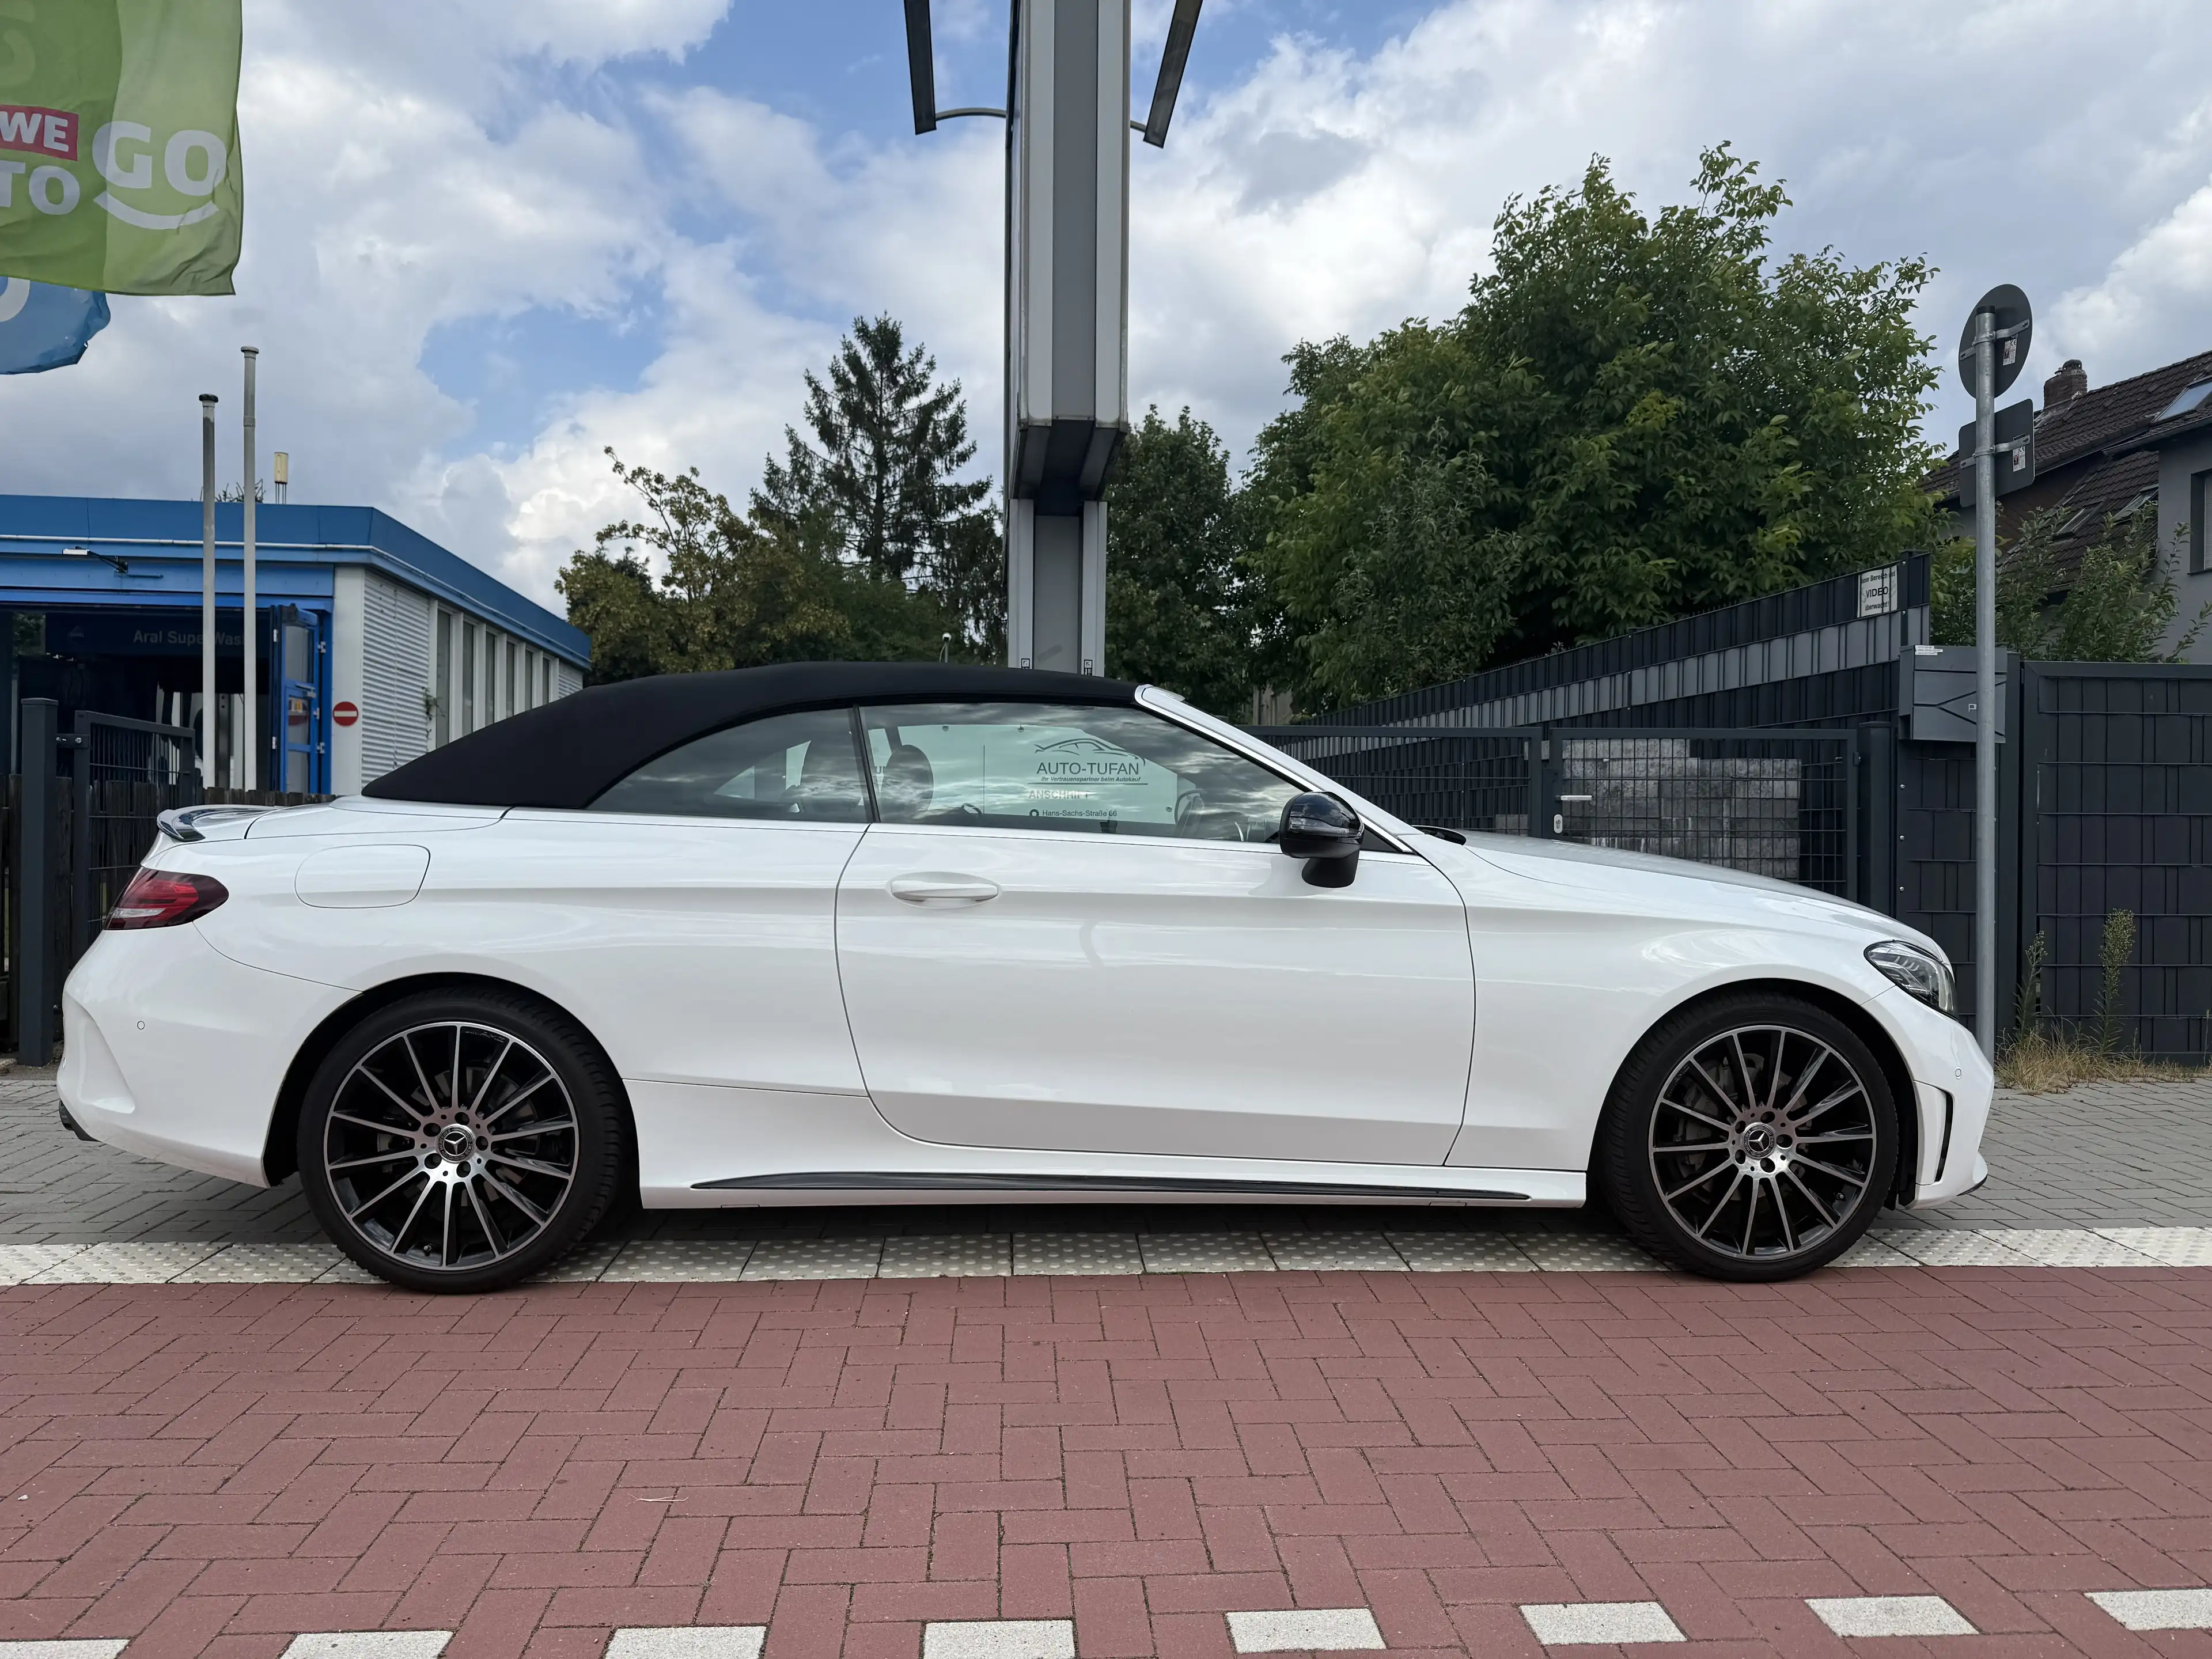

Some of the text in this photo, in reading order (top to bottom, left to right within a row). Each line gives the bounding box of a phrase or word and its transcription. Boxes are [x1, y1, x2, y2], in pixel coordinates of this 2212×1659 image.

[0, 111, 69, 151] WE
[0, 121, 227, 215] TO GO
[1866, 586, 1888, 598] VIDEO
[134, 630, 162, 643] Aral
[1037, 762, 1139, 775] AUTO-TUFAN
